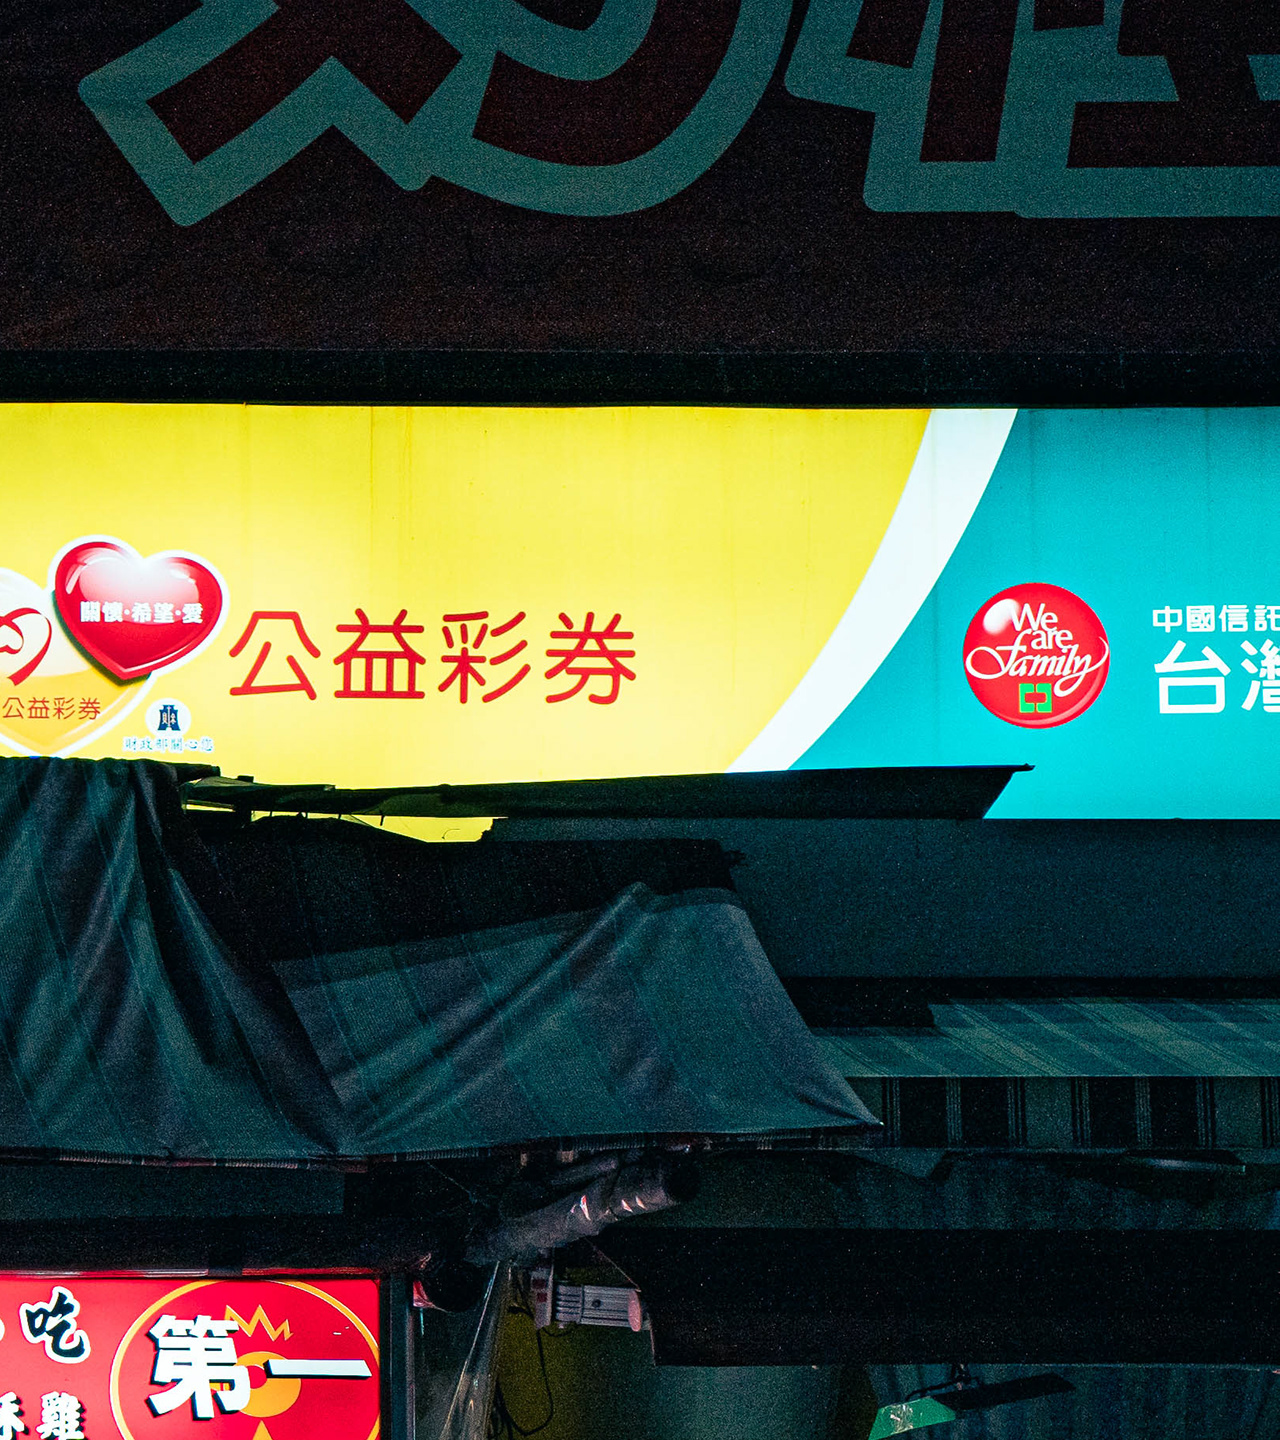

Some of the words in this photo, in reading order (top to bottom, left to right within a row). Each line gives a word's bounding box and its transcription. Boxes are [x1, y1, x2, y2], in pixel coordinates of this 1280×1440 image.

[1012, 602, 1059, 632] We
[1030, 629, 1074, 651] care
[228, 607, 637, 705] 公益彩券
[1, 695, 102, 722] 公益彩券
[148, 1314, 373, 1420] 第一
